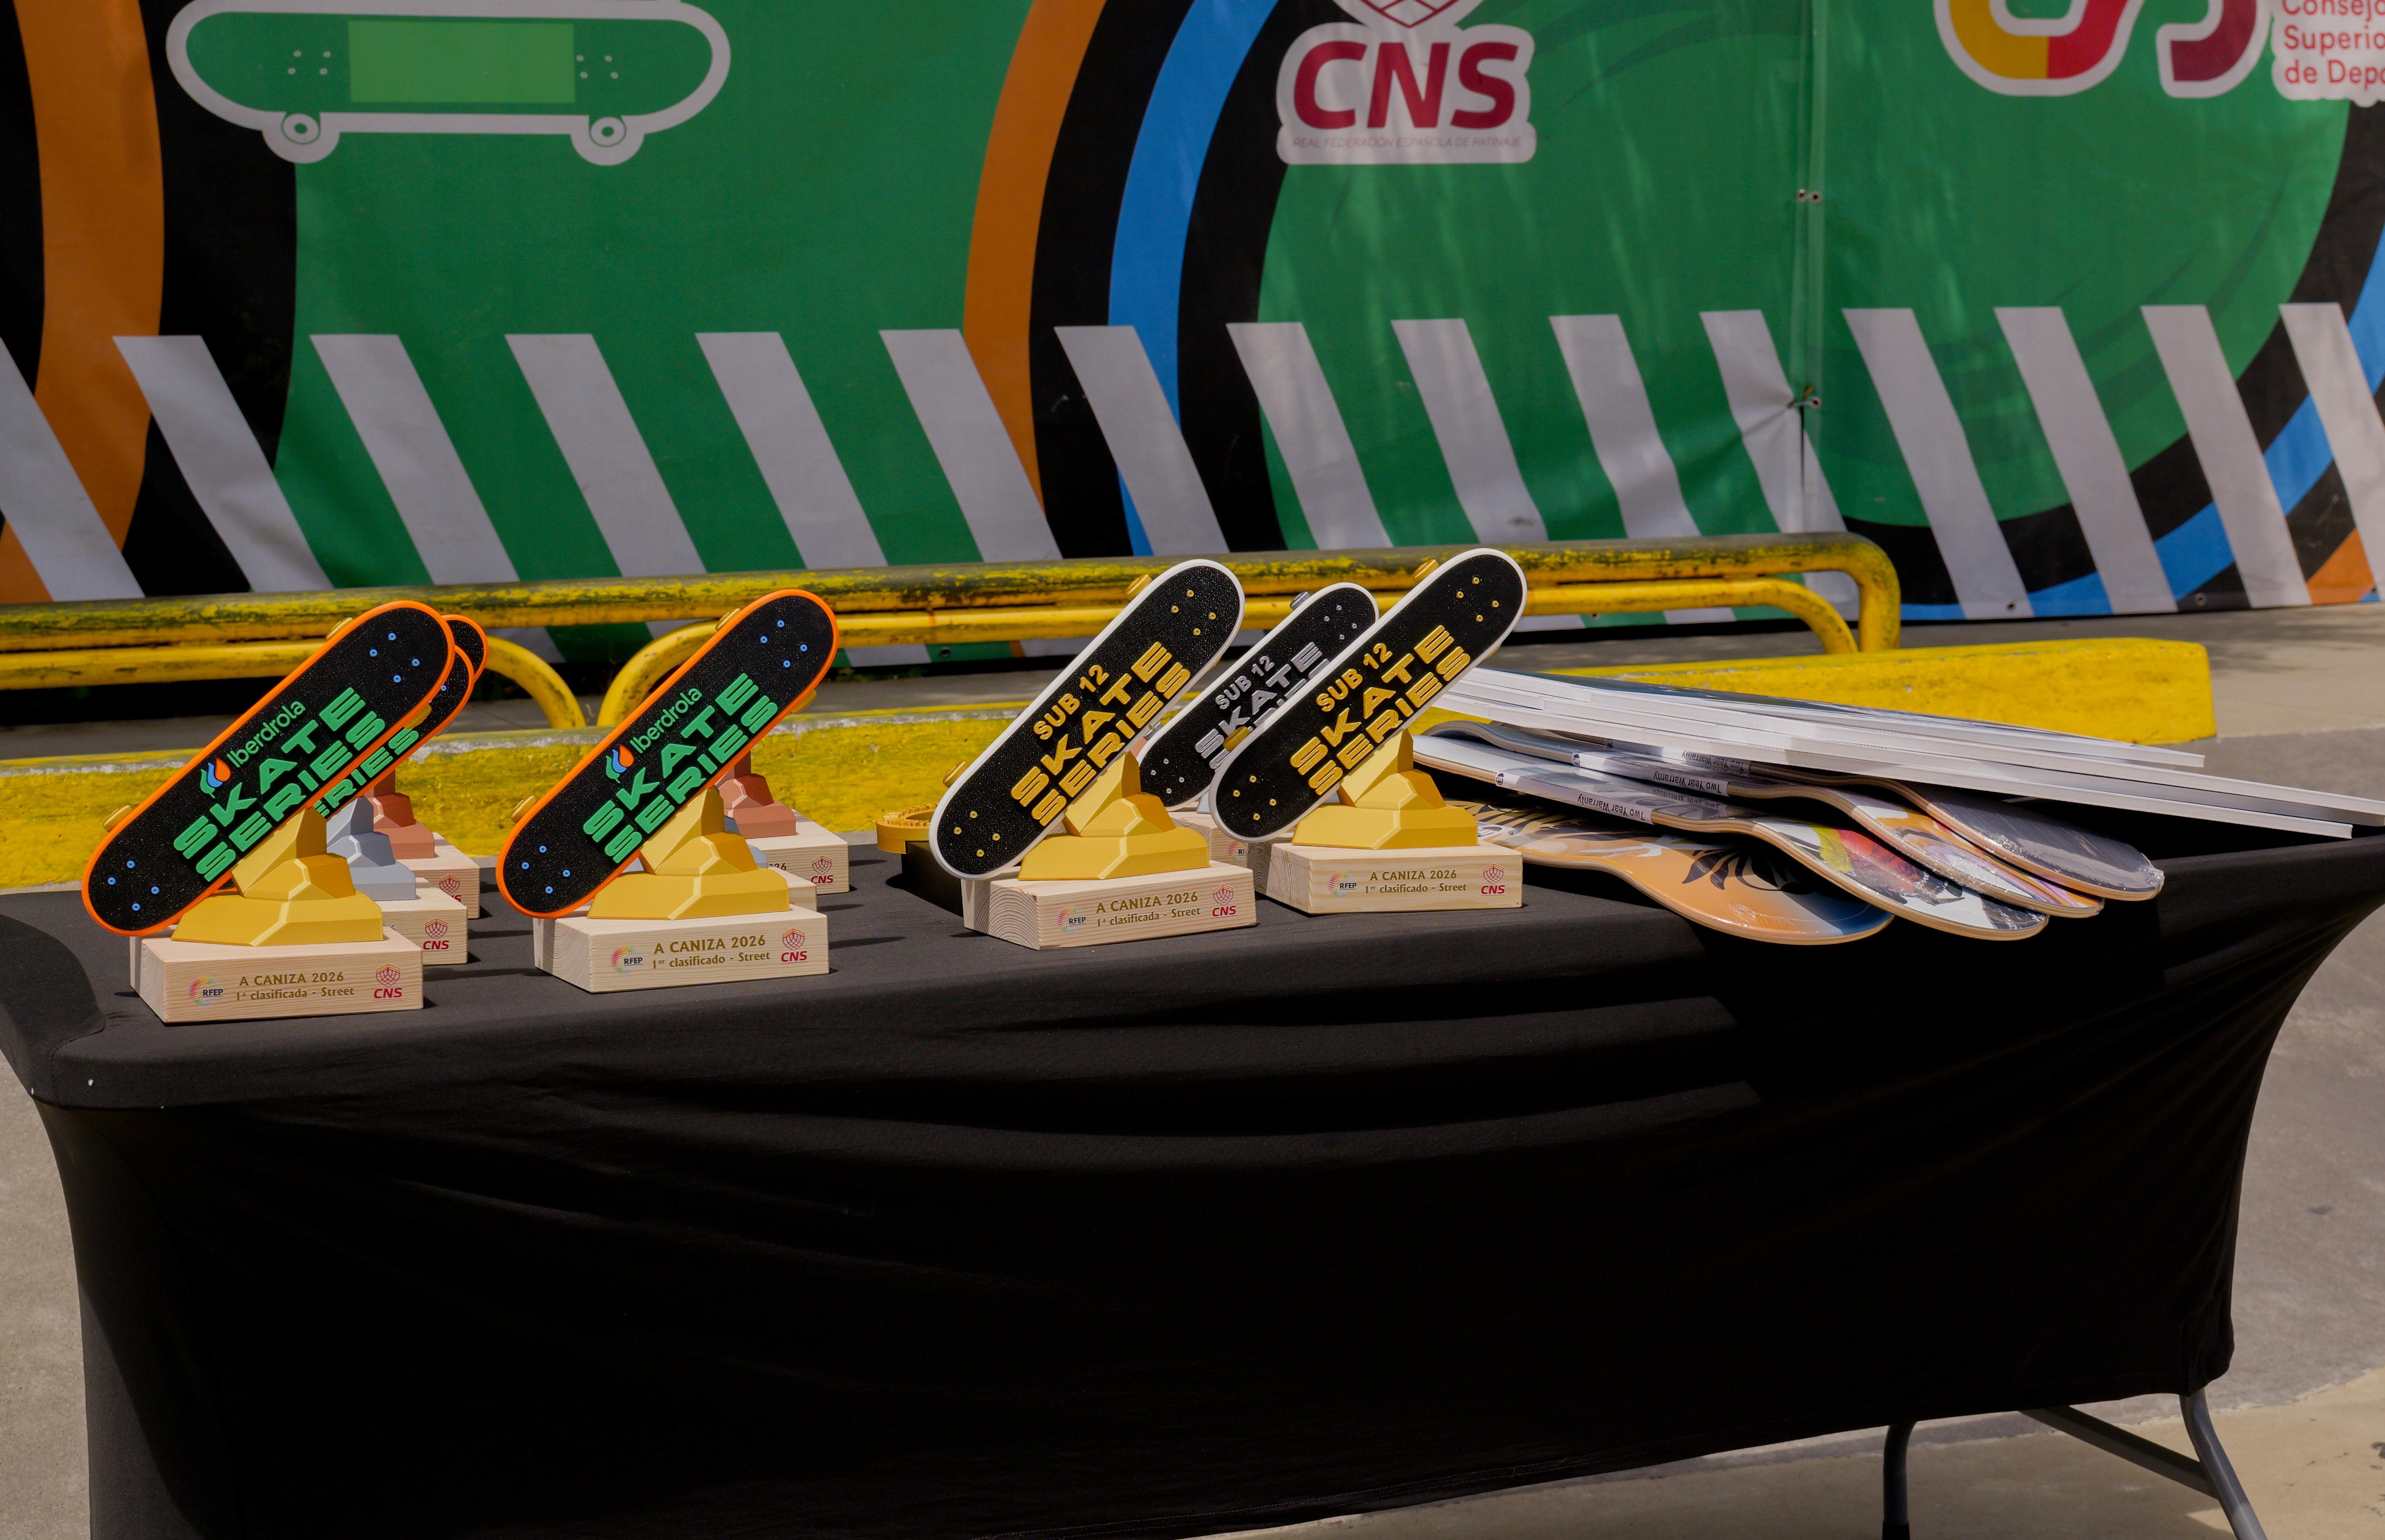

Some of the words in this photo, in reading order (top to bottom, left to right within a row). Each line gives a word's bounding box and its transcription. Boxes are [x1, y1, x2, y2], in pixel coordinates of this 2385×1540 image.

[2283, 0, 2385, 22] Consejo
[2285, 25, 2385, 55] Superio
[2285, 59, 2317, 83] de
[1294, 40, 1519, 129] CNS
[1293, 137, 1319, 146] REAL
[1456, 137, 1470, 147] DE
[1215, 675, 1252, 709] SUB
[1252, 656, 1275, 676] 12
[1316, 669, 1364, 712] SUB
[1363, 643, 1393, 670] 12
[1033, 692, 1080, 740] SUB
[1079, 664, 1109, 693] 12
[1195, 641, 1323, 759] SKATE
[1290, 625, 1455, 776] SKATE
[630, 687, 703, 754] Iberdrola
[1011, 641, 1172, 807] SKATE
[1308, 646, 1470, 796] SERIES
[226, 701, 306, 768] Iberdrola
[1031, 662, 1190, 827] SERIES
[583, 673, 759, 843] SKATE
[1682, 750, 1712, 766] Warranty
[1713, 758, 1729, 768] Year
[1731, 762, 1744, 771] Two
[173, 687, 366, 859] SKATE
[605, 695, 778, 864] SERIES
[1654, 771, 1686, 787] Warranty
[1688, 778, 1704, 790] Year
[1706, 782, 1721, 793] Two
[196, 711, 385, 882] SERIES
[1577, 794, 1610, 812] Warranty
[1612, 805, 1628, 817] Year
[1630, 809, 1646, 821] Two
[811, 875, 833, 883] CNS
[1370, 872, 1378, 880] A
[1382, 870, 1425, 880] CANIZA
[1430, 870, 1456, 879] 2026
[1380, 883, 1427, 893] clasificado
[1439, 883, 1467, 891] Street
[1481, 885, 1505, 894] CNS
[1096, 902, 1105, 913] A
[1110, 896, 1162, 911] CANIZA
[1167, 891, 1198, 905] 2026
[1212, 905, 1236, 917] CNS
[1110, 913, 1160, 925] clasificada
[1171, 907, 1201, 918] Street
[423, 940, 450, 950] CNS
[654, 943, 665, 954] A
[670, 938, 726, 953] CANIZA
[732, 935, 766, 948] 2026
[670, 954, 725, 967] clasificado
[738, 951, 770, 962] Street
[781, 951, 808, 962] CNS
[239, 976, 249, 986] A
[254, 973, 307, 985] CANIZA
[312, 972, 344, 983] 2026
[250, 988, 307, 1000] clasificada
[321, 986, 354, 996] Street
[374, 988, 403, 999] CNS
